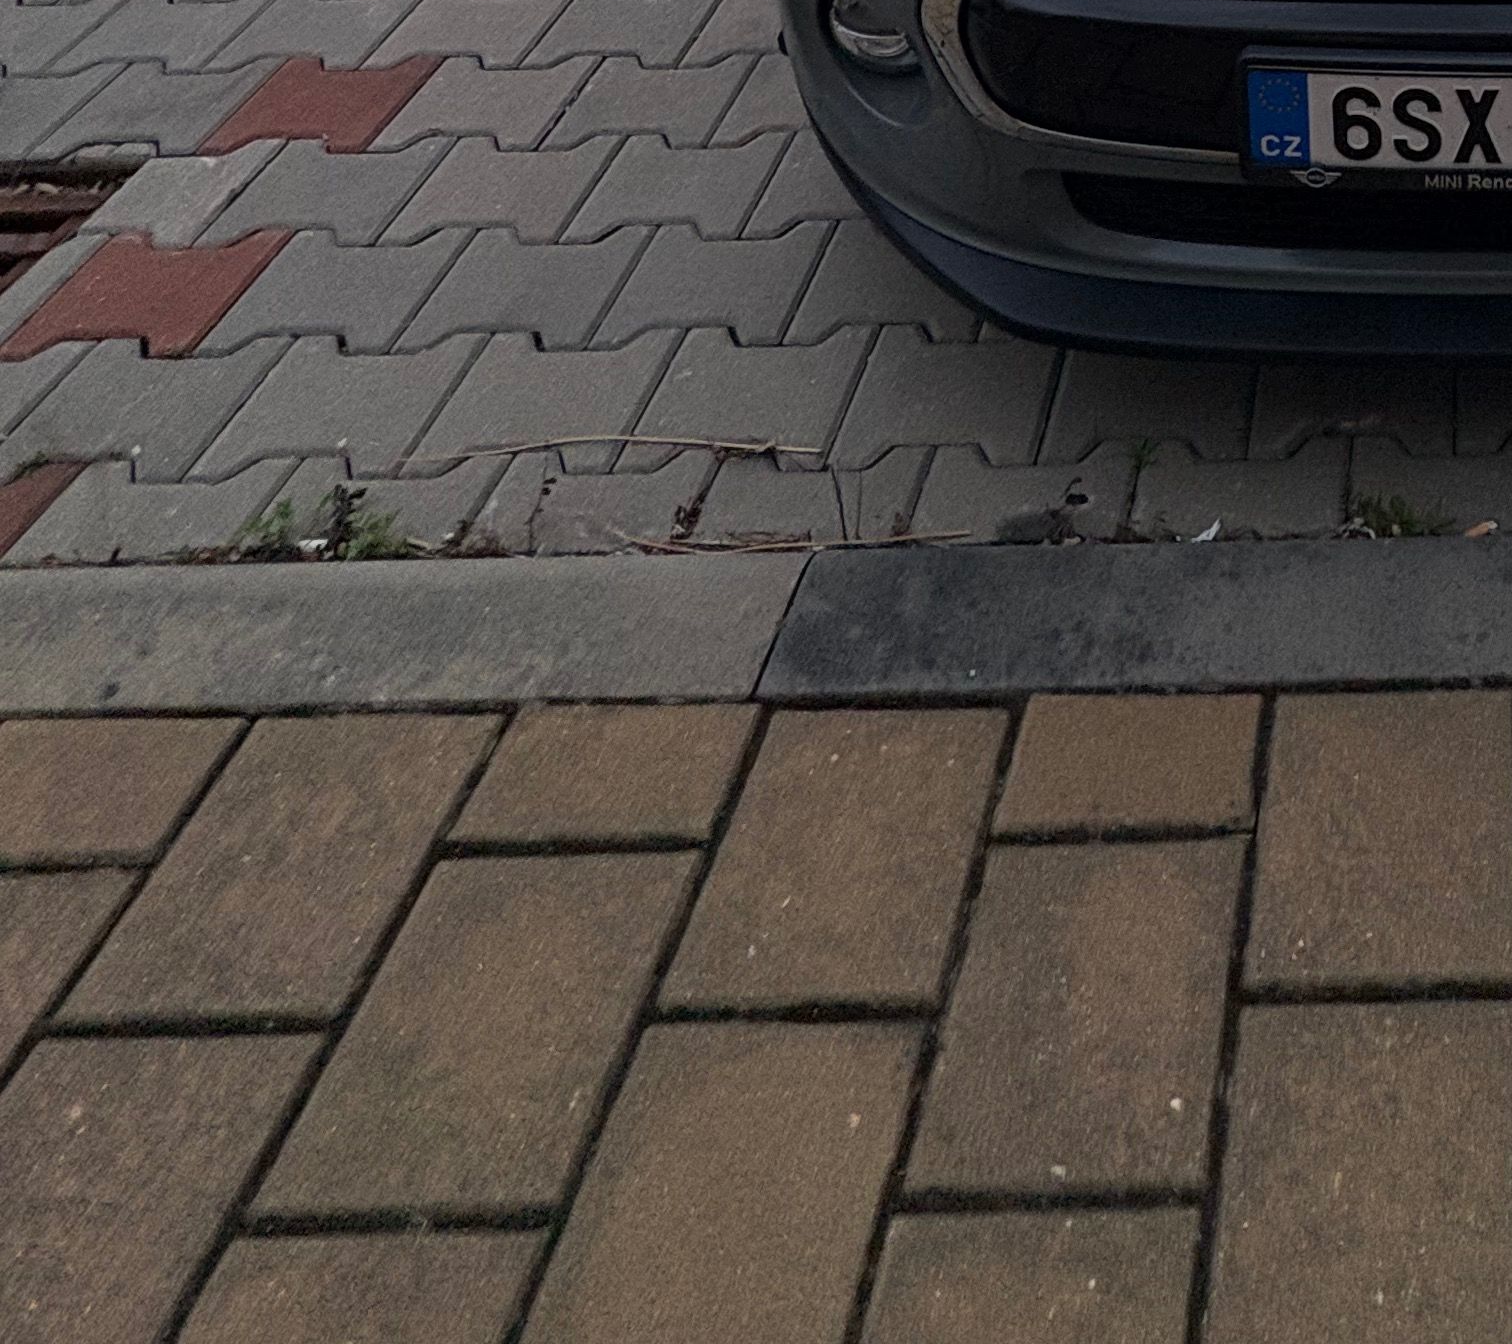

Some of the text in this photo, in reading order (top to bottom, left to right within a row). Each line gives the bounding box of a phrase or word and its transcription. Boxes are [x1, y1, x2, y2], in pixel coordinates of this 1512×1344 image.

[1331, 86, 1503, 164] 6SX
[1260, 134, 1303, 158] CZ
[1424, 174, 1462, 189] MINI
